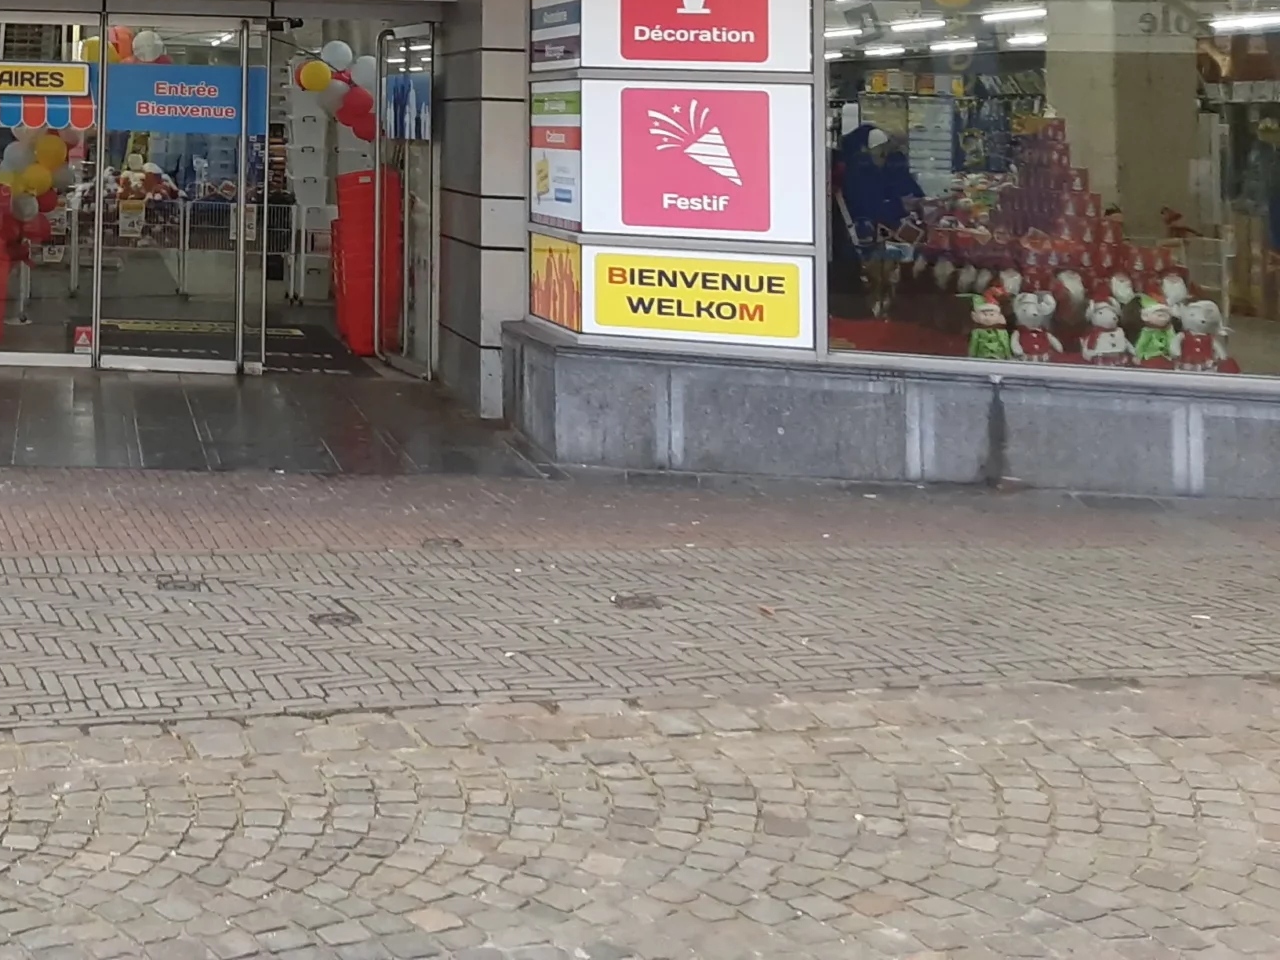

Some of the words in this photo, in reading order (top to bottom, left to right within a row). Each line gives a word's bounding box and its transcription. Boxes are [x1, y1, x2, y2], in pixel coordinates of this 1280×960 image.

[634, 25, 755, 43] Décoration
[155, 81, 218, 97] Entrée
[137, 101, 236, 118] Bienvenue
[663, 193, 730, 211] Festif
[608, 267, 785, 294] BIENVENUE
[626, 296, 764, 322] WELKOM
